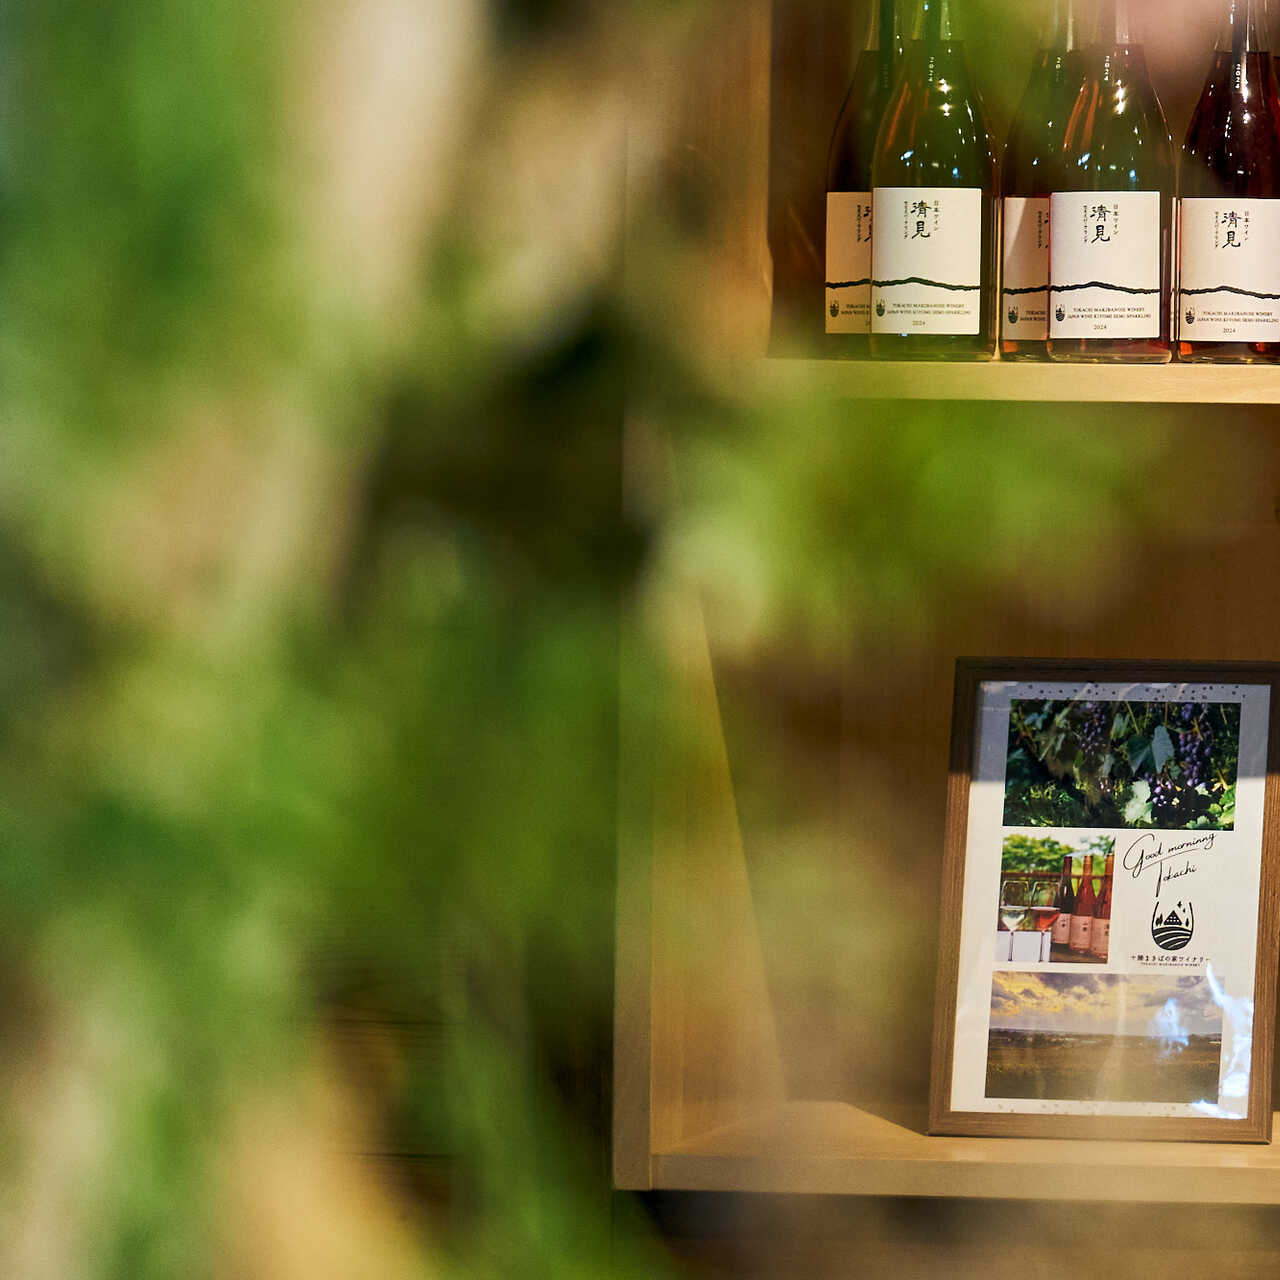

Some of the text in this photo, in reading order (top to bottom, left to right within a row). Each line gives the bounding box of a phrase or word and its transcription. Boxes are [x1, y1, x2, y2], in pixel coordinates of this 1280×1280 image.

[909, 200, 931, 240] 清見
[1090, 204, 1112, 243] 清見
[1221, 211, 1241, 248] 清見
[1123, 833, 1162, 878] Good
[1155, 860, 1197, 898] Tokachi
